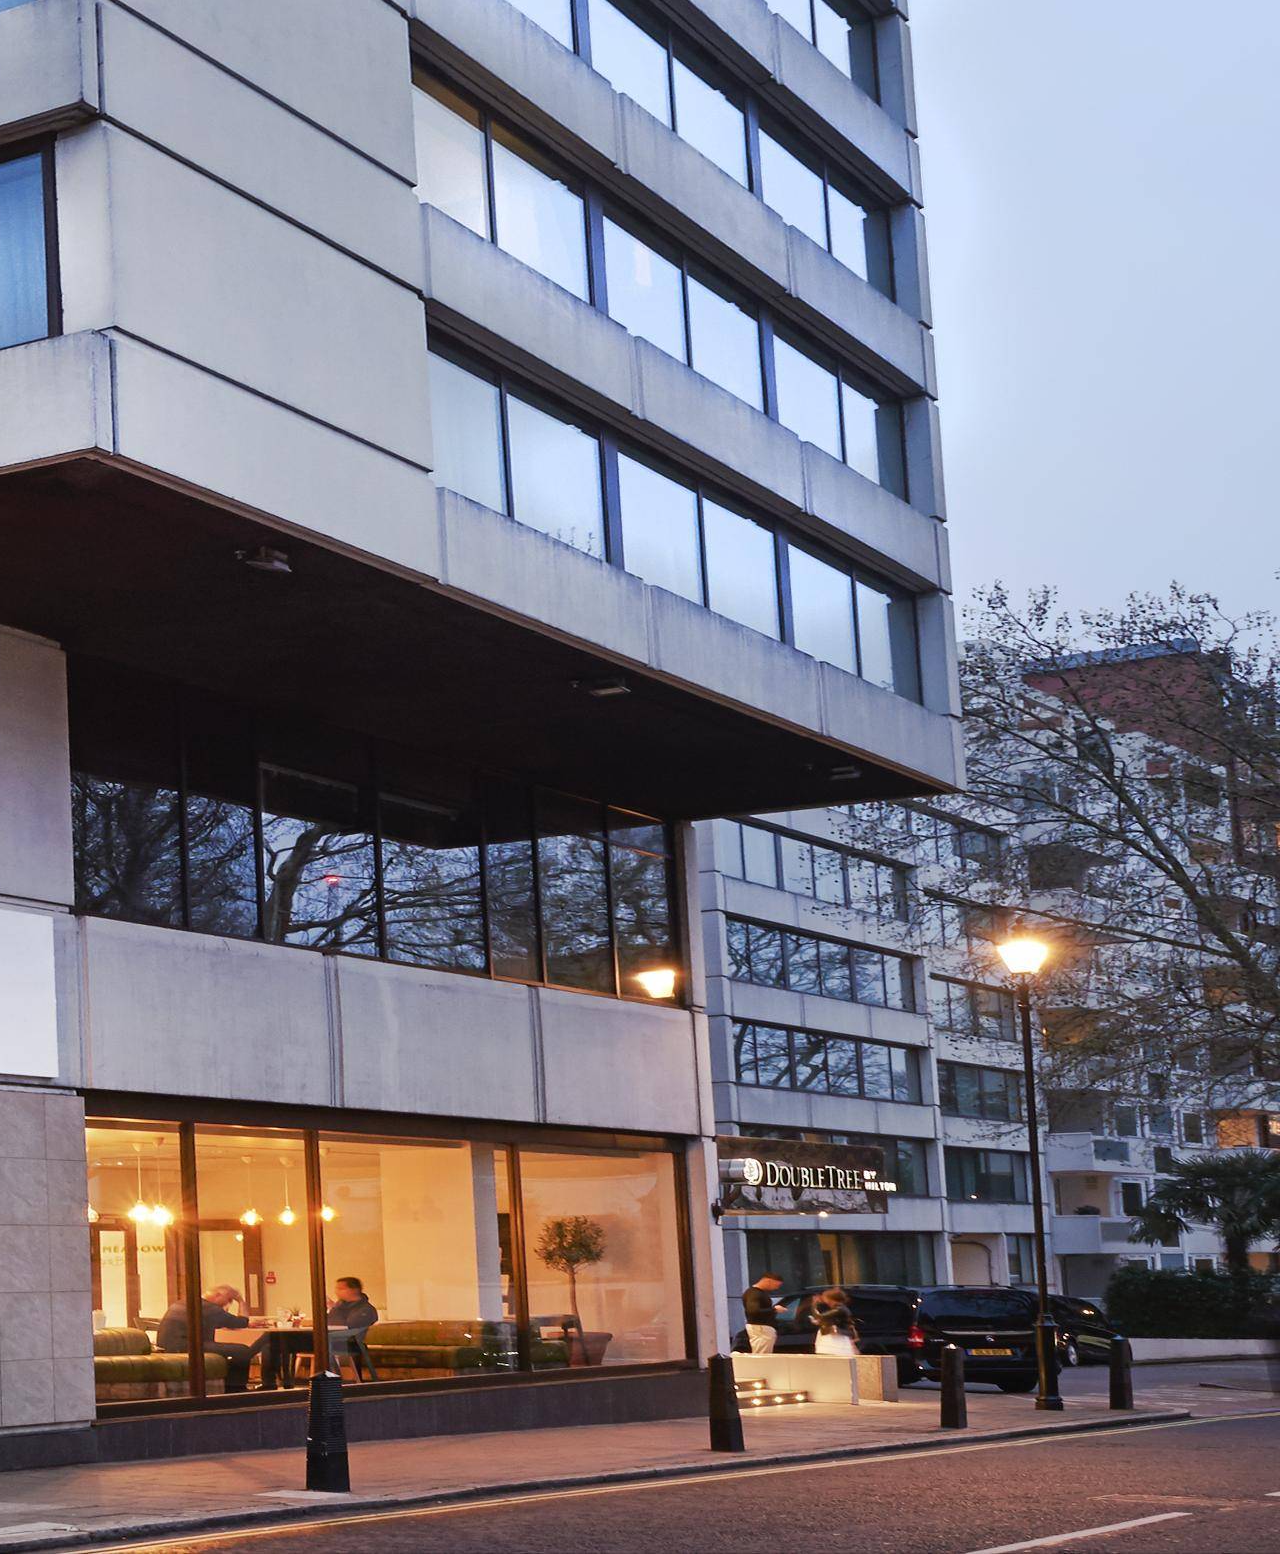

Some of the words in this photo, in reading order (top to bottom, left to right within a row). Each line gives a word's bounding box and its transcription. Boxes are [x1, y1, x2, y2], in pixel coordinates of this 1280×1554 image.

[765, 1161, 862, 1190] DOUBLETREE
[863, 1170, 877, 1180] BY
[864, 1181, 897, 1192] HILTON
